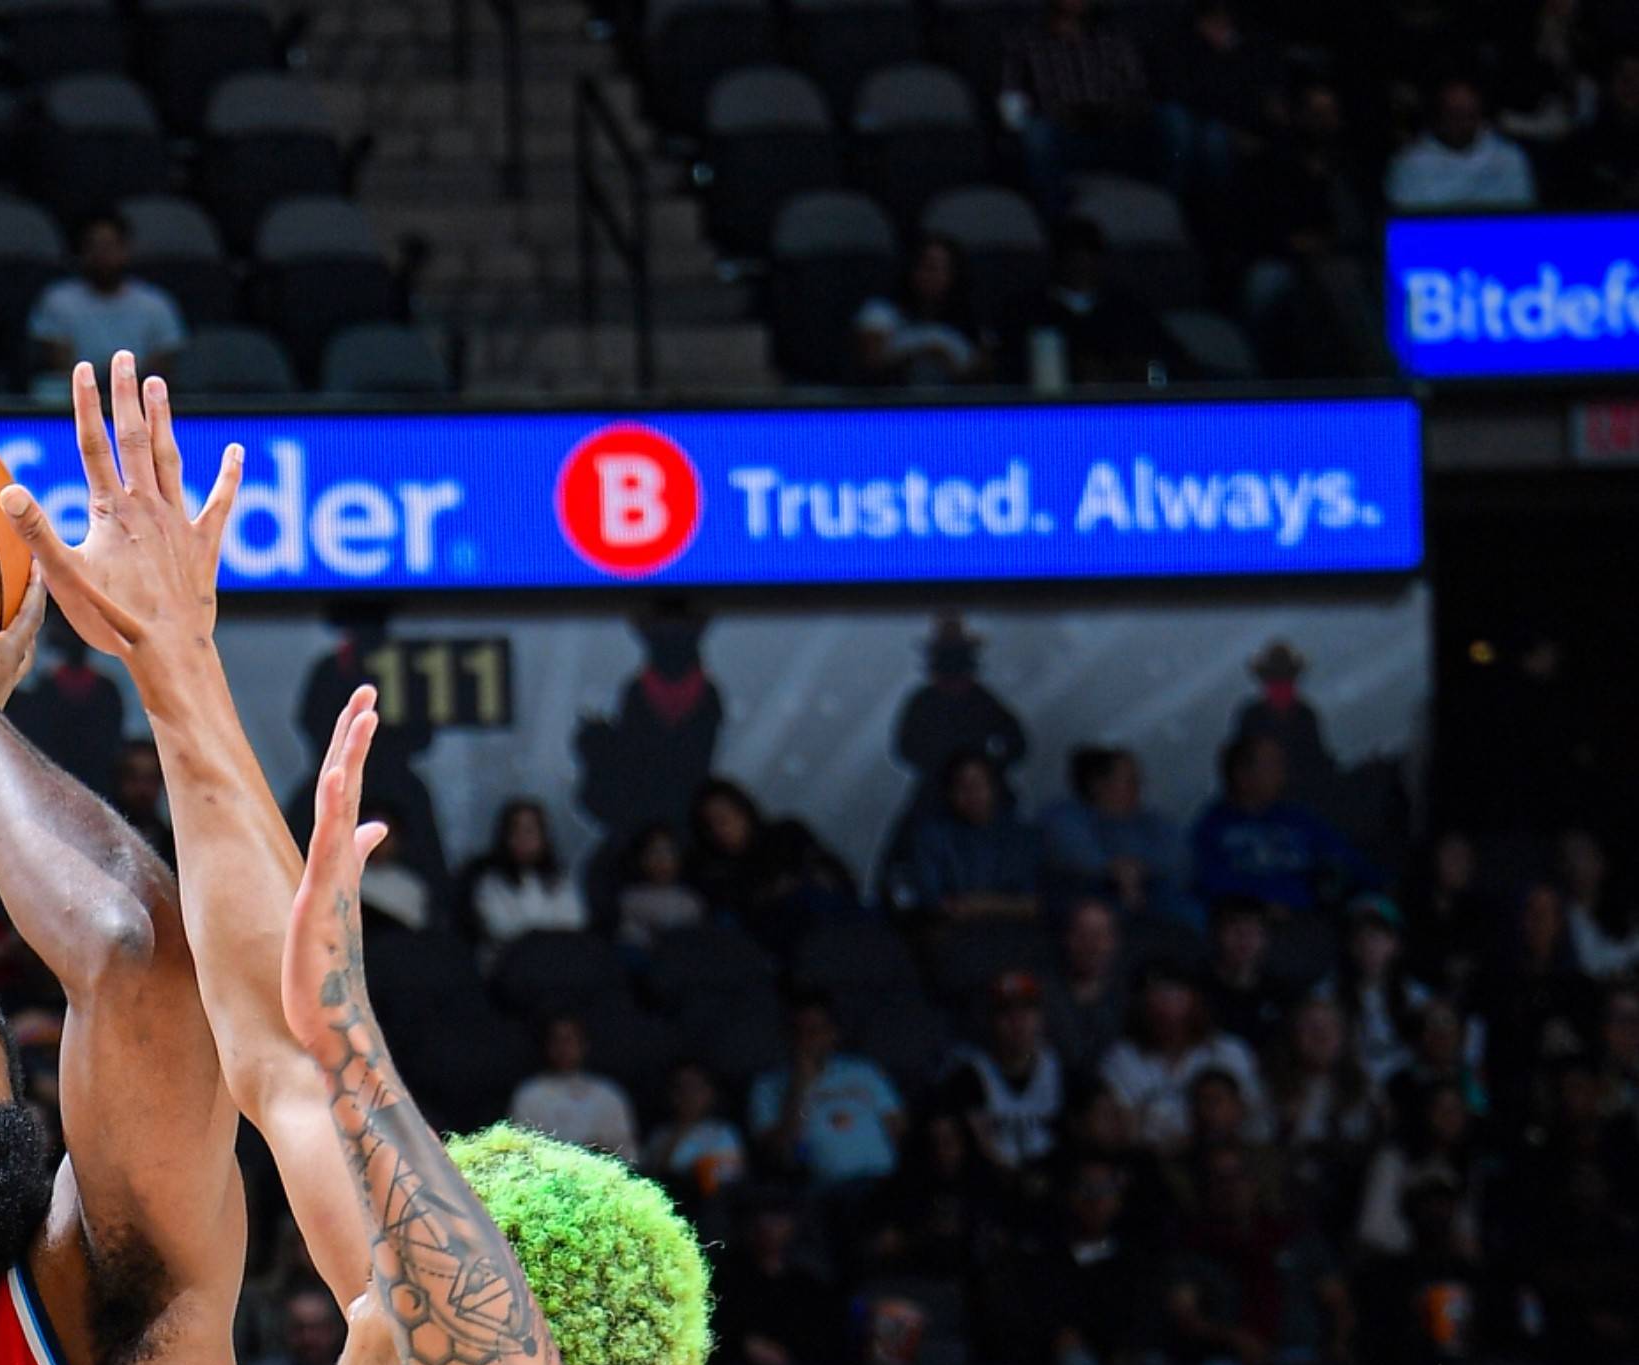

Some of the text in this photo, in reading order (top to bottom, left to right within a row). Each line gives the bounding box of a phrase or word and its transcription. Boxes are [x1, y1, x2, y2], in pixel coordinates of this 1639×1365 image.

[729, 455, 1383, 549] Trusted. Always.
[363, 645, 500, 724] 111
